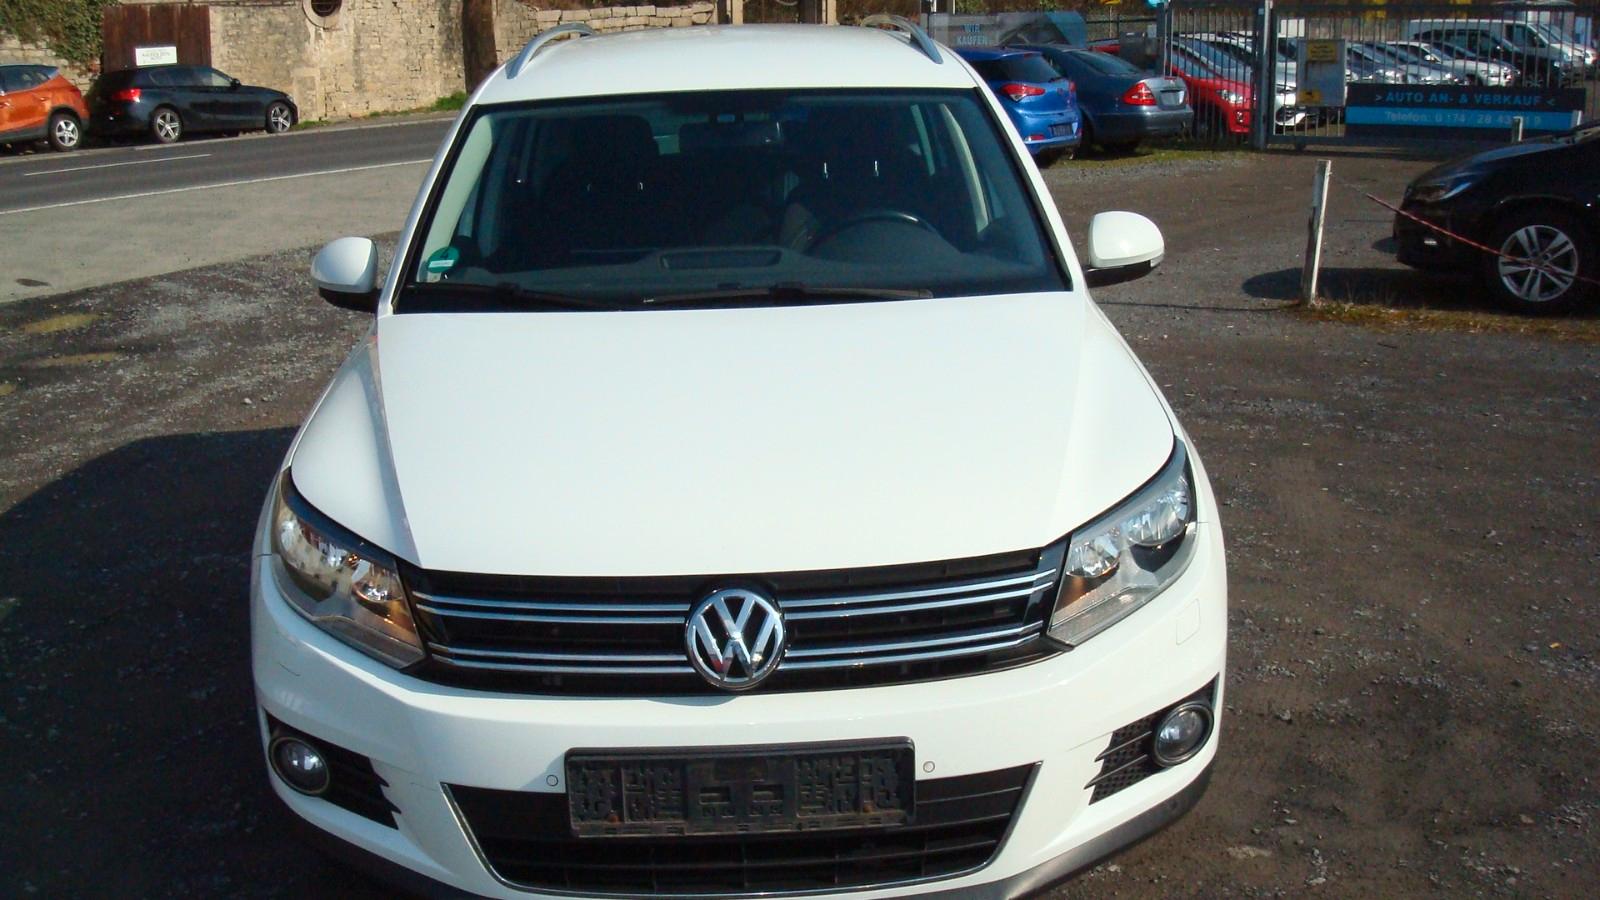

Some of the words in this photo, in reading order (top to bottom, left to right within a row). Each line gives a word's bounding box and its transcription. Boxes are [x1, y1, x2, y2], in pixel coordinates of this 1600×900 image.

[1386, 91, 1424, 102] AUTO
[1459, 93, 1468, 104] &
[1474, 94, 1542, 106] VERKAUF
